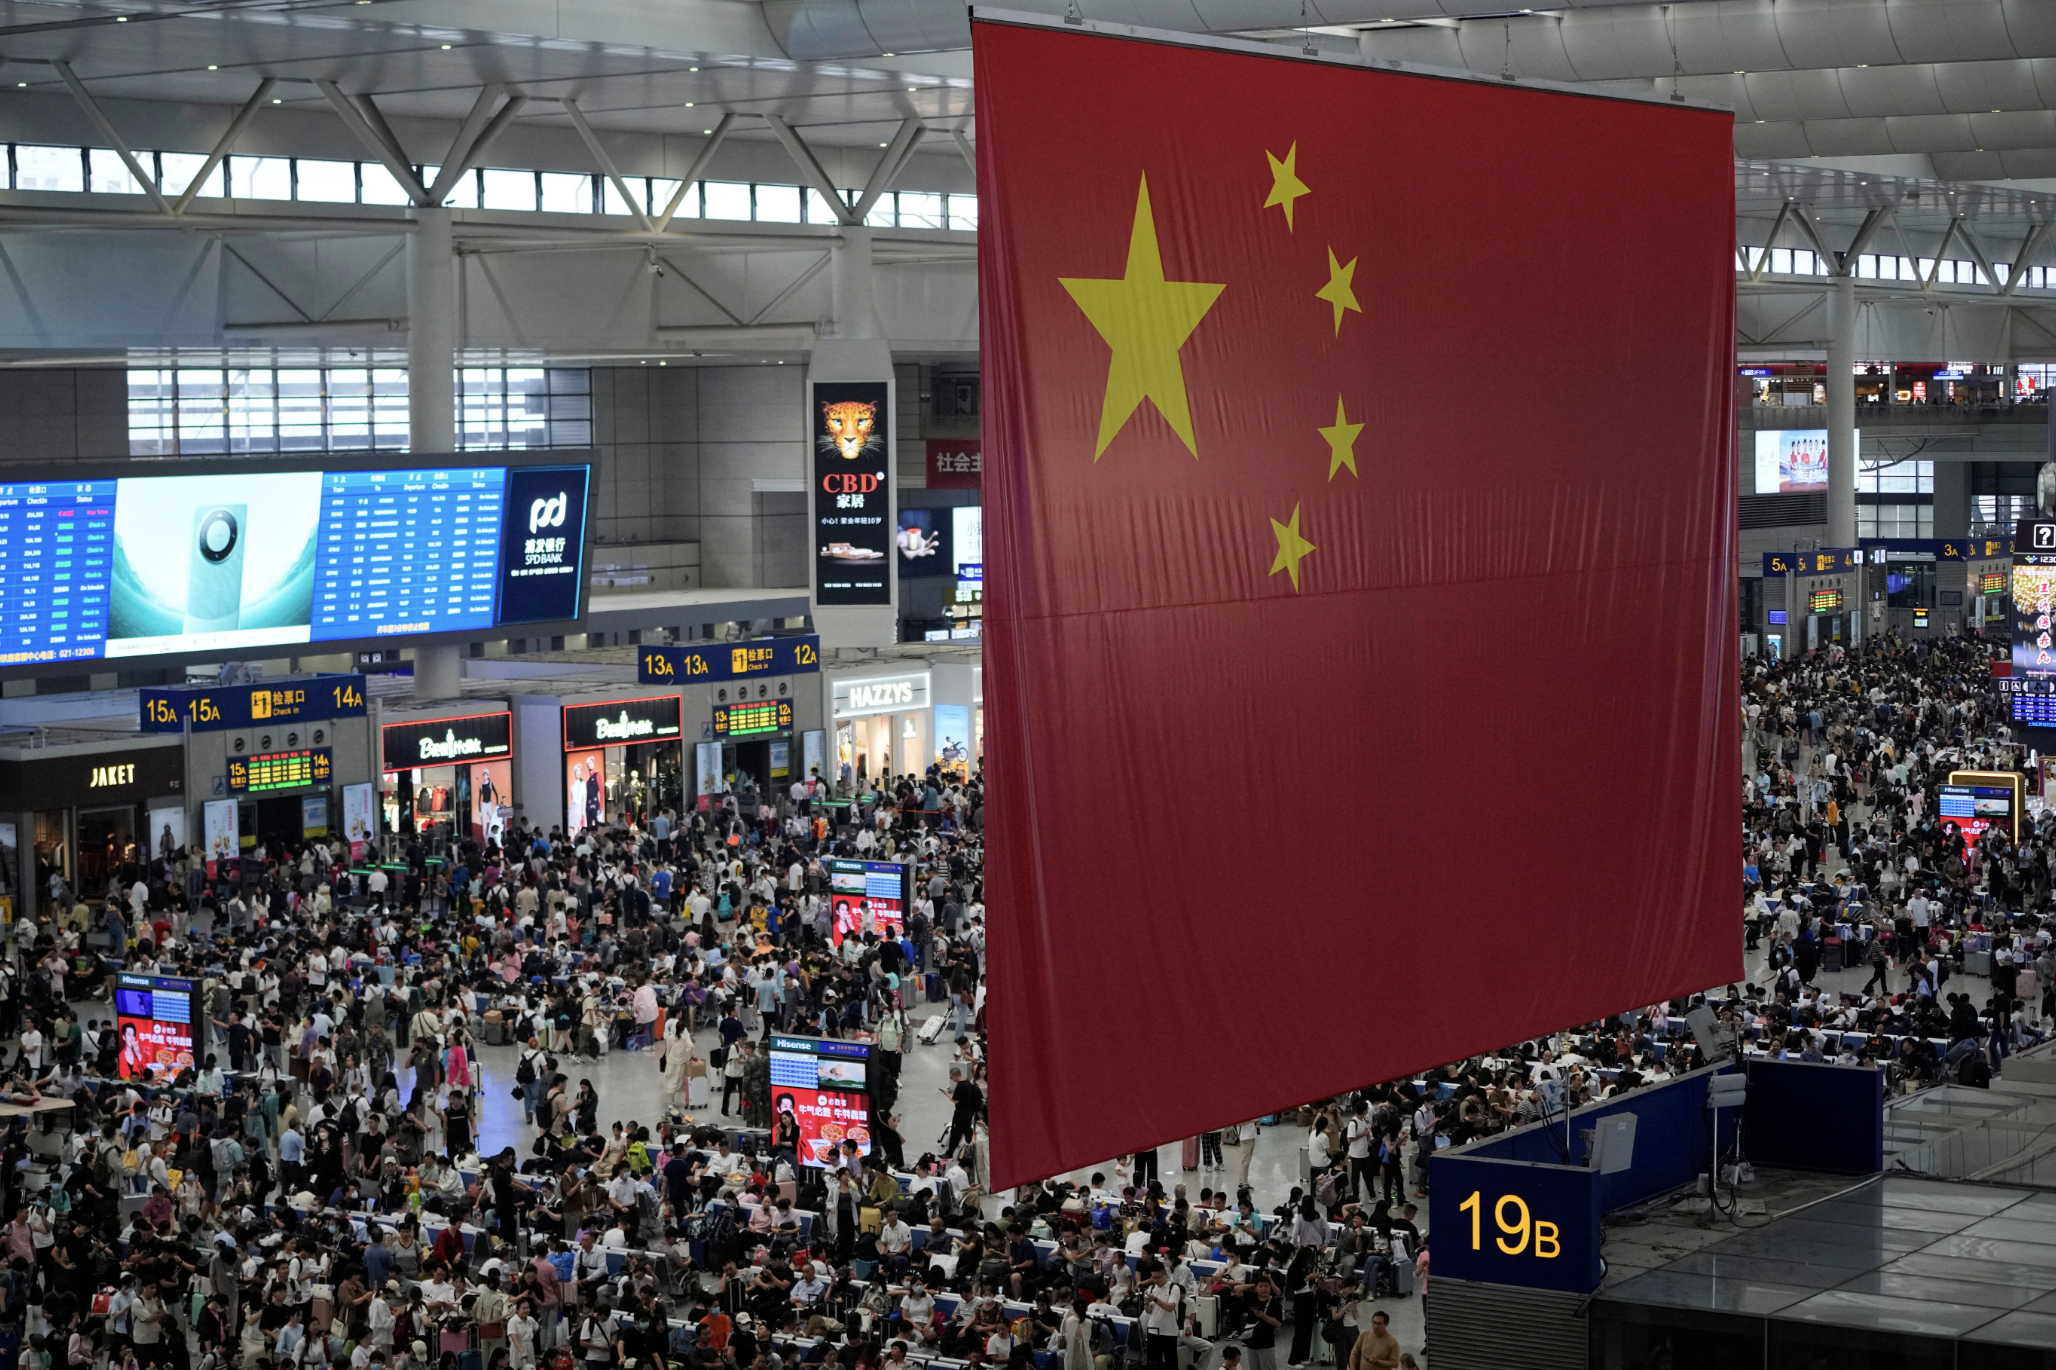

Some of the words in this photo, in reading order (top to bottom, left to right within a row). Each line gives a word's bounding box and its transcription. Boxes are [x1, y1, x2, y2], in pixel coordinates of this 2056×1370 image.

[823, 473, 878, 493] CBD
[836, 494, 865, 509] 家居
[525, 537, 566, 554] 浦发银行
[1944, 544, 1958, 557] 3A
[1970, 544, 1976, 556] 3A
[525, 554, 540, 565] SPD
[541, 553, 562, 564] BANK
[1772, 558, 1787, 572] 5A
[1799, 558, 1806, 571] 5A
[1845, 554, 1852, 566] 4A
[2038, 583, 2050, 662] 王氏保赤丸
[60, 648, 95, 657] 021-12306
[748, 648, 773, 662] 检票口
[794, 644, 817, 664] 12A
[645, 654, 674, 676] 13A
[684, 655, 708, 676] 13A
[272, 690, 305, 706] 检票口
[333, 685, 363, 708] 14A
[850, 682, 912, 708] HAZZYS
[147, 700, 178, 722] 15A
[189, 699, 221, 722] 15A
[273, 708, 291, 717] Check
[715, 711, 728, 722] 13A
[779, 704, 791, 715] 12A
[313, 754, 329, 767] 14A
[90, 764, 135, 787] JAKET
[230, 763, 246, 776] 15A
[122, 976, 149, 985] Hisense
[777, 1040, 812, 1050] Hisense
[799, 1104, 831, 1117] 牛气必胜
[1459, 1190, 1561, 1258] 19B
